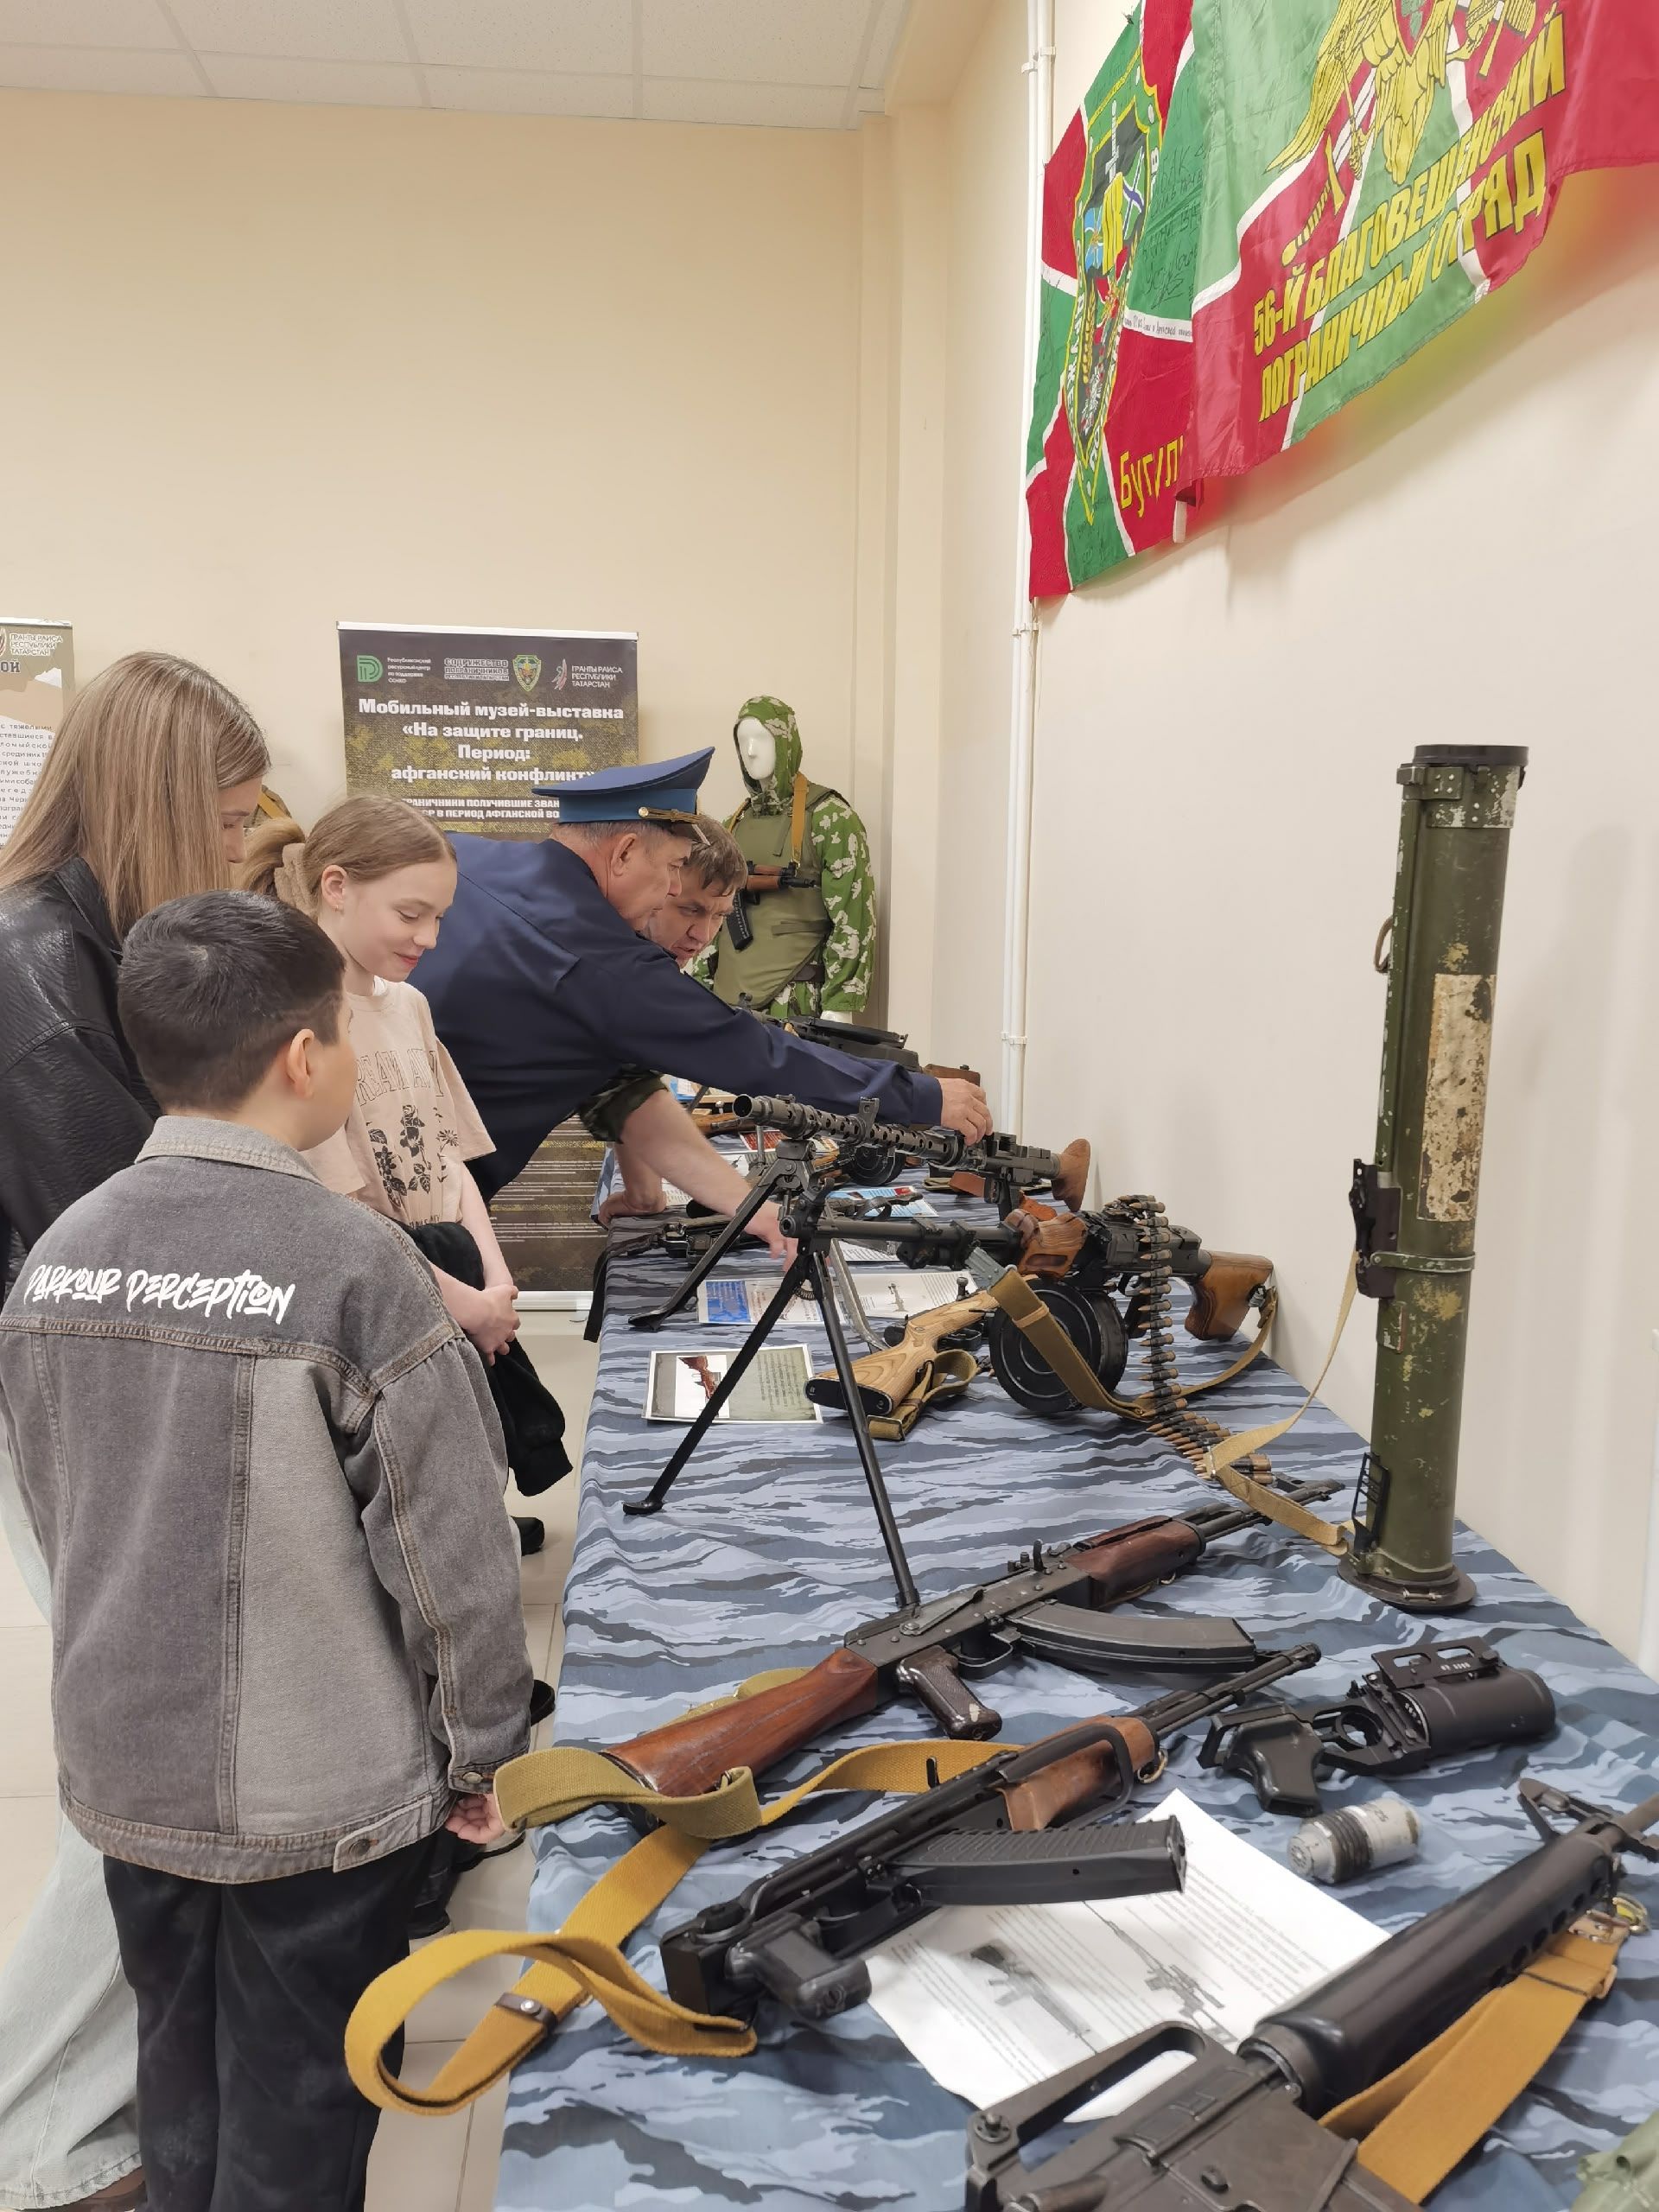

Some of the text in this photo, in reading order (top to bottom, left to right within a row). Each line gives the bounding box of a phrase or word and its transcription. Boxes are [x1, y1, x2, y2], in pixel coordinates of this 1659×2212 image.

[1254, 263, 1307, 357] 56-Й
[1303, 3, 1566, 321] БЛАГОВЕЩЕНСКИЙ
[1258, 223, 1437, 423] ПОГРАНИЧНЫЙ
[1431, 128, 1548, 283] ОТРЯД
[444, 658, 508, 669] СОДРУЖЕСТВО
[571, 664, 623, 674] ГРАНТЫ РАИСА
[444, 666, 509, 676] ПОГРАНИЧНИКОВ
[571, 672, 616, 681] РЕСПУБЛИКИ
[571, 680, 611, 689] ТАТАРСТАН
[359, 698, 624, 721] Мобильный музей-выставка
[402, 721, 583, 742] «На защите границ.
[458, 744, 531, 762] Период:
[391, 766, 492, 783] афганский
[467, 799, 533, 808] ПОЛУЧИВШИЕ
[445, 810, 486, 820] ПЕРИОД
[486, 809, 544, 818] АФГАНСКОЙ
[23, 1264, 296, 1325] PARKOUR PERCEPTION
